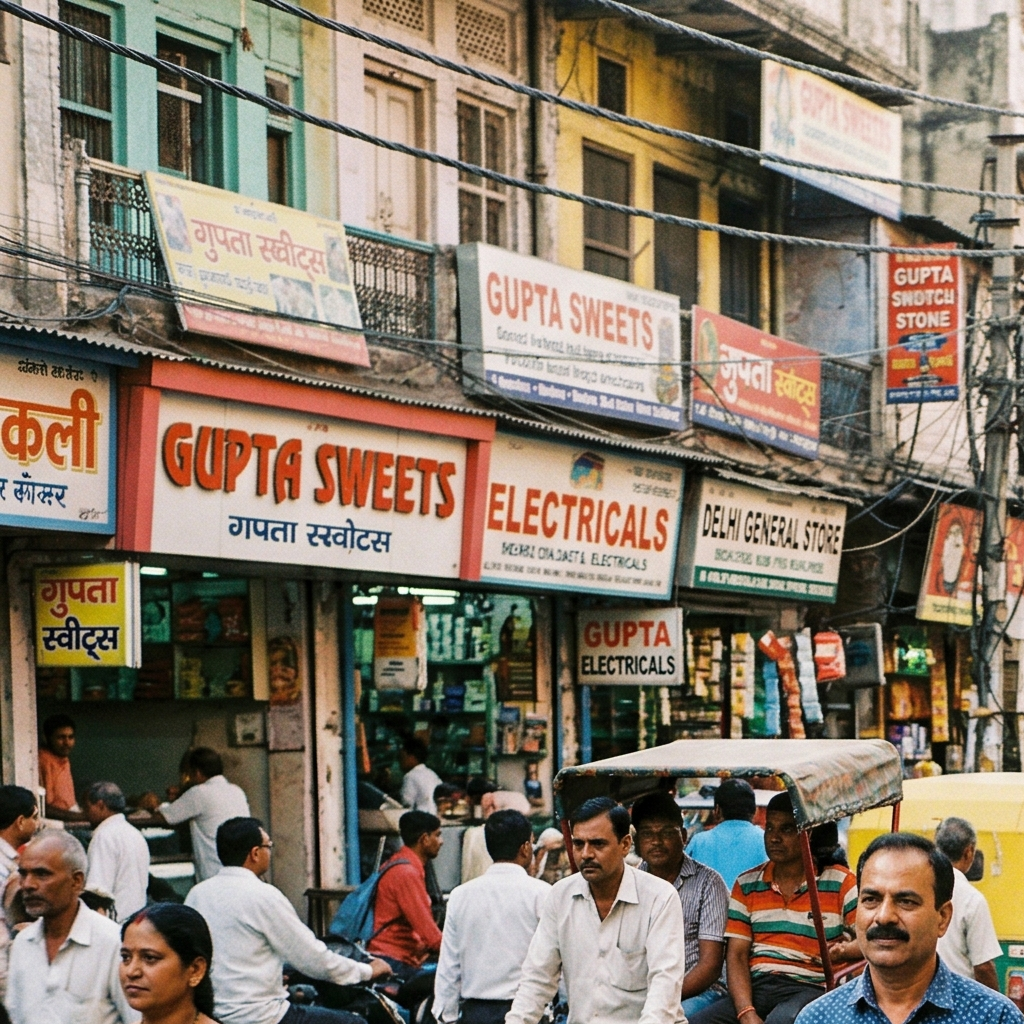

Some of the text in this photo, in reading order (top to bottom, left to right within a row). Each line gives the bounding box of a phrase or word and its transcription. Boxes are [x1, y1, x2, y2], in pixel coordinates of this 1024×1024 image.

[893, 265, 954, 286] GUPTA
[486, 271, 563, 330] GUPTA
[569, 291, 653, 351] SWEETS
[895, 310, 951, 329] STONE
[162, 421, 457, 519] GUPTA SWEETS
[487, 482, 669, 553] ELECTRICALS
[702, 503, 841, 555] DELHI GENERAL STORE
[39, 577, 119, 618] गुपता
[42, 616, 120, 660] स्वीट्स
[583, 620, 671, 648] GUPTA
[581, 654, 676, 677] ELECTRICALS
